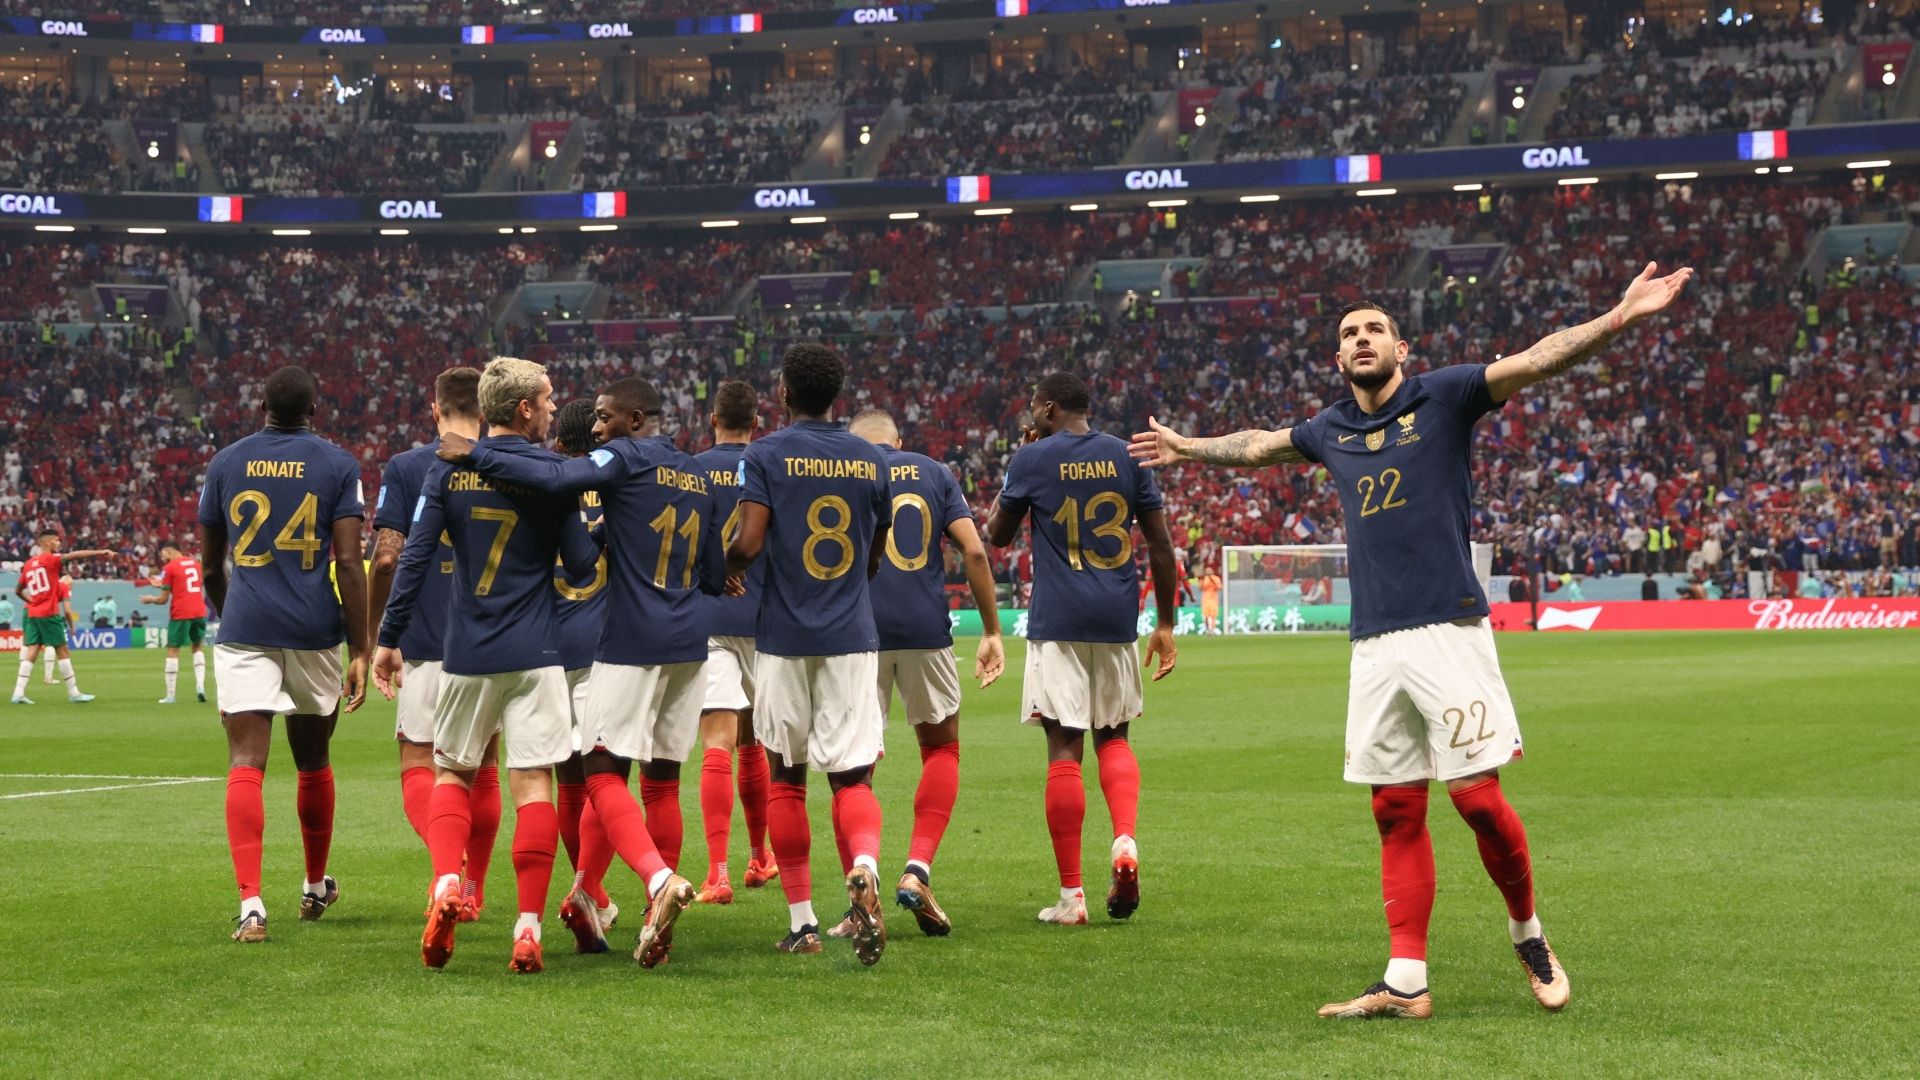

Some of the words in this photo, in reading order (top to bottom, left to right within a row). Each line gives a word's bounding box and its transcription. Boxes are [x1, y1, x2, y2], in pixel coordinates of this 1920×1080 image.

[853, 7, 898, 24] GOAL
[41, 20, 87, 37] GOAL
[320, 28, 366, 43] GOAL
[589, 23, 633, 37] GOAL
[1522, 146, 1590, 169] GOAL
[1125, 168, 1189, 190] GOAL
[0, 194, 61, 215] GOAL
[380, 200, 443, 219] GOAL
[754, 188, 816, 208] GOAL
[246, 460, 306, 478] KONATE
[656, 465, 709, 497] DEMBELE
[784, 457, 878, 481] TCHOUAMENI
[891, 464, 921, 482] PPE
[1059, 460, 1118, 481] FOFANA
[1357, 467, 1408, 518] 22
[229, 489, 322, 570] 24
[802, 495, 855, 581] 8
[885, 493, 932, 572] 0
[1052, 491, 1132, 571] 13
[470, 506, 519, 596] 7
[649, 503, 700, 590] 11
[26, 567, 51, 597] 20
[184, 567, 201, 593] 2
[1748, 598, 1918, 630] Budweiser
[1442, 700, 1496, 749] 22
